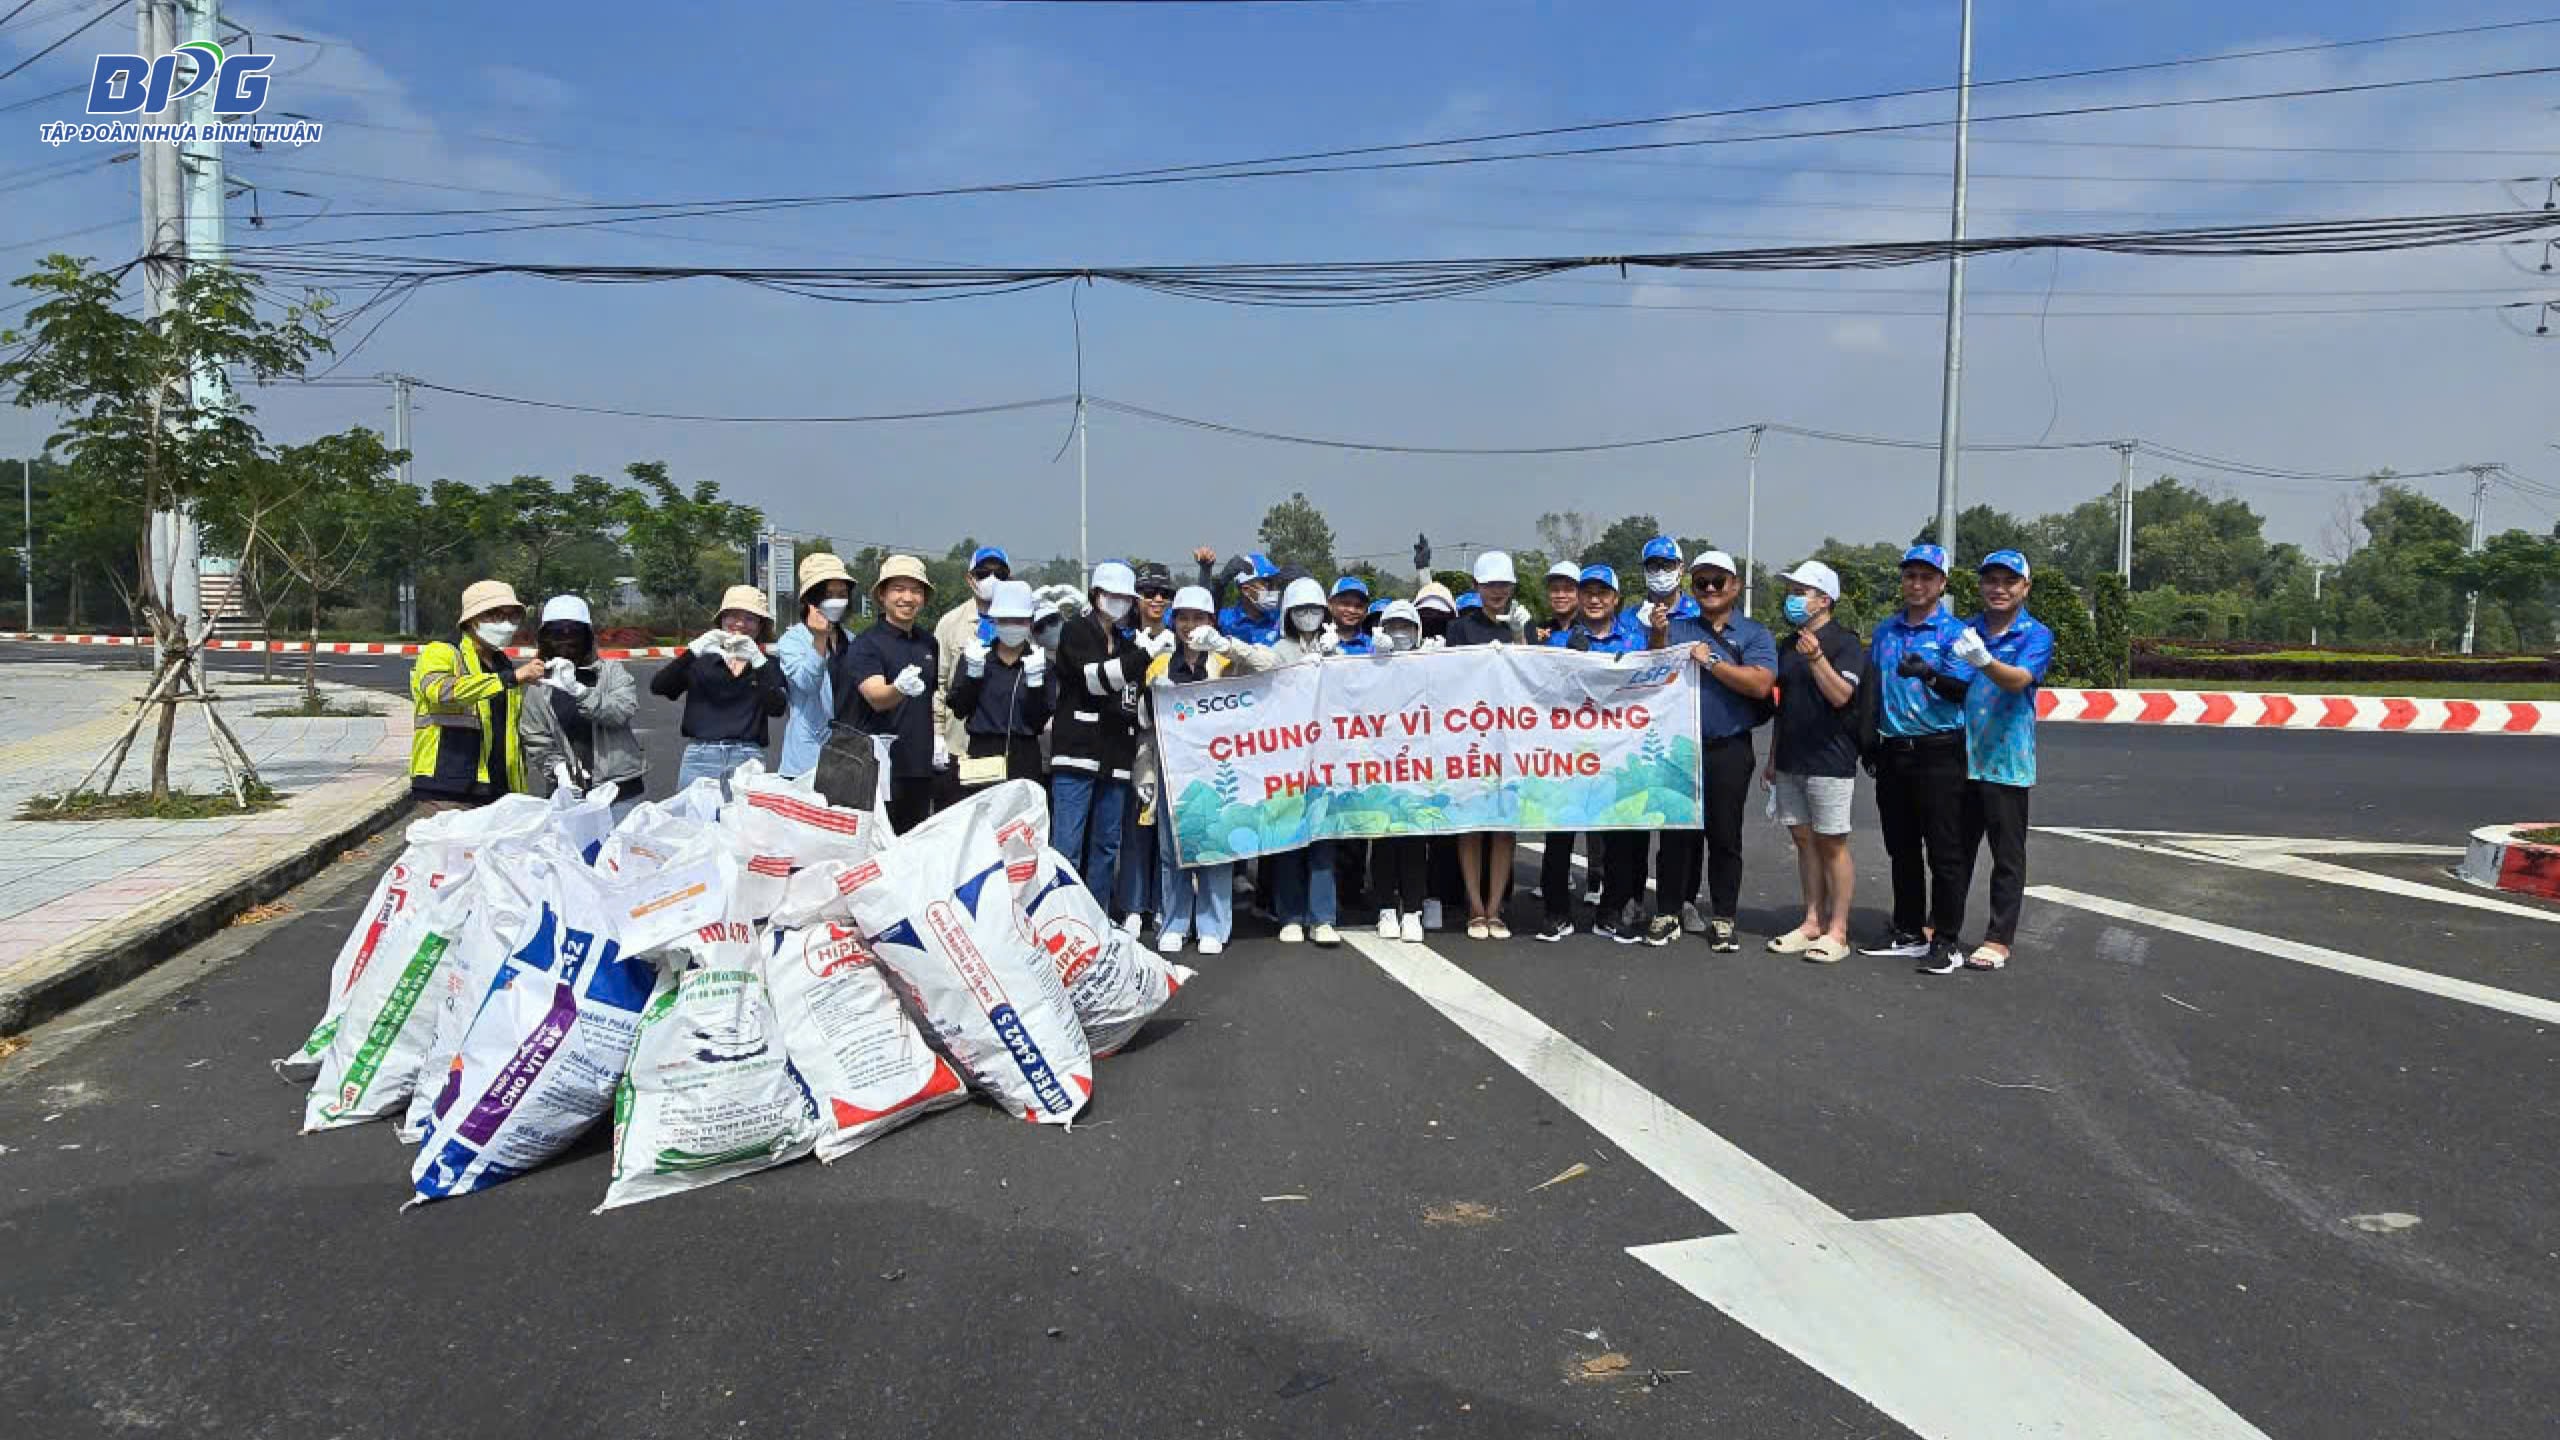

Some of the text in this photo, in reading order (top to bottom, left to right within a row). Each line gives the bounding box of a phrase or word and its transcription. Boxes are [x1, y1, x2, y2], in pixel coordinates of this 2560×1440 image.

[1197, 690, 1255, 714] SCGC
[1208, 696, 1649, 762] CHUNG TAY VÌ CỘNG ĐỒNG
[1264, 742, 1601, 800] PHÁT TRIỂN BỀN VỮNG
[1031, 1070, 1073, 1113] HIPER
